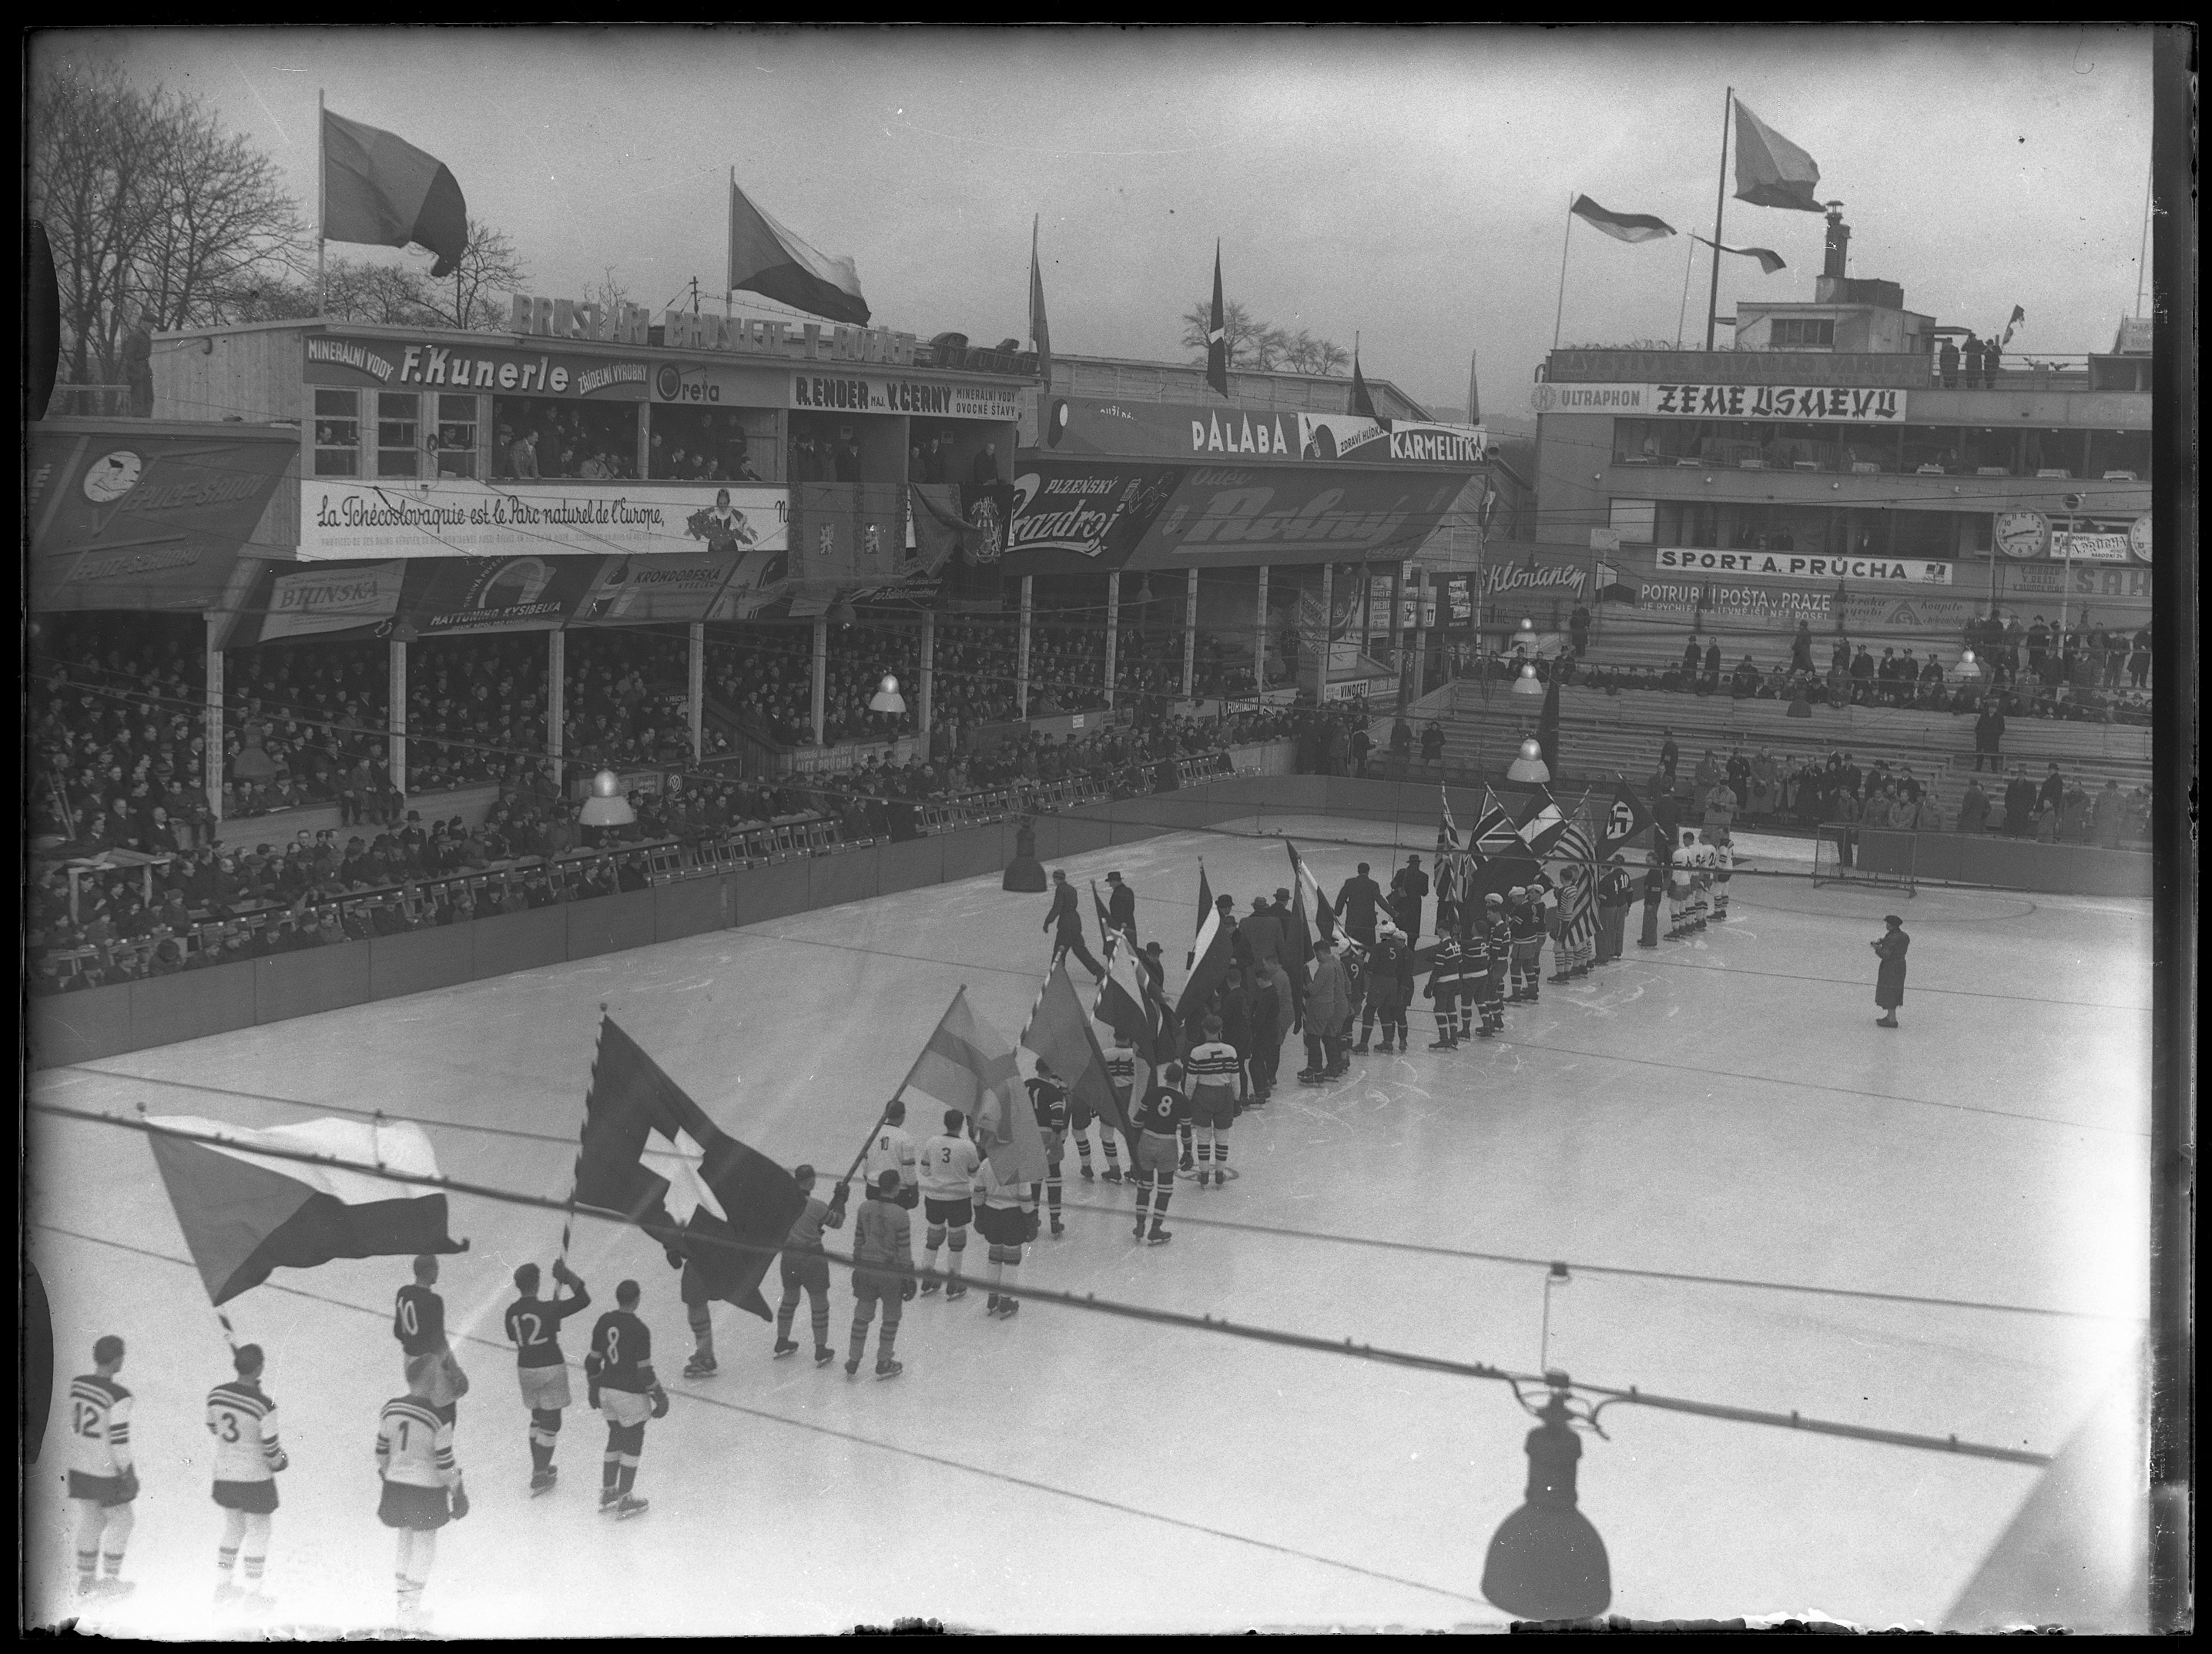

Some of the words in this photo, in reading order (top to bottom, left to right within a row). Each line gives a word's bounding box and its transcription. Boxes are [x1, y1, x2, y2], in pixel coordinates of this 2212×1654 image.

[308, 338, 367, 367] MINERÁLNÍ
[365, 353, 394, 381] VODY
[400, 346, 569, 392] F.Kunerle
[577, 363, 613, 396] ZŘÍDELNÍ
[613, 362, 648, 382] VÝROBKY
[656, 363, 719, 403] Oreta
[796, 376, 869, 409] R.ENDER
[871, 395, 886, 407] MAJ.
[886, 379, 952, 414] V.ČERNÝ
[956, 387, 997, 402] MINERÁLNÍ
[997, 390, 1016, 403] VODY
[956, 400, 988, 415] OVOCNÉ
[990, 403, 1016, 417] ŠŤÁVY
[1561, 390, 1641, 407] ULTRAPHON
[1191, 409, 1289, 455] PALABA
[1389, 428, 1485, 463] KARMELITKA
[1044, 475, 1119, 494] PLZEŇSKÝ
[1189, 467, 1254, 488] Oděv
[317, 500, 341, 528] La
[344, 495, 467, 534] Tchécoslovaquie
[470, 504, 491, 525] est
[491, 501, 508, 525] le
[508, 496, 541, 526] Parc
[543, 499, 594, 525] naturel
[595, 500, 610, 525] de
[610, 497, 665, 534] l'Europe,
[1011, 472, 1126, 553] Prazdroj
[1181, 487, 1413, 545] Rolný
[1661, 550, 1754, 571] SPORT
[1761, 556, 1782, 572] A.
[1789, 556, 1908, 579] PRŮCHA
[501, 601, 562, 618] KYSIBELKA
[1656, 602, 1710, 614] RYCHLEJ
[1720, 586, 1769, 608] POŠTA
[1781, 591, 1832, 611] PRAZE
[1389, 945, 1397, 960] 5
[1349, 962, 1360, 979] 9
[1156, 1094, 1175, 1118] 8
[940, 1147, 953, 1164] 3
[396, 1296, 420, 1336] 10
[509, 1312, 550, 1347] 12
[606, 1325, 622, 1365] 8
[72, 1401, 104, 1439] 12
[217, 1411, 242, 1445] 3
